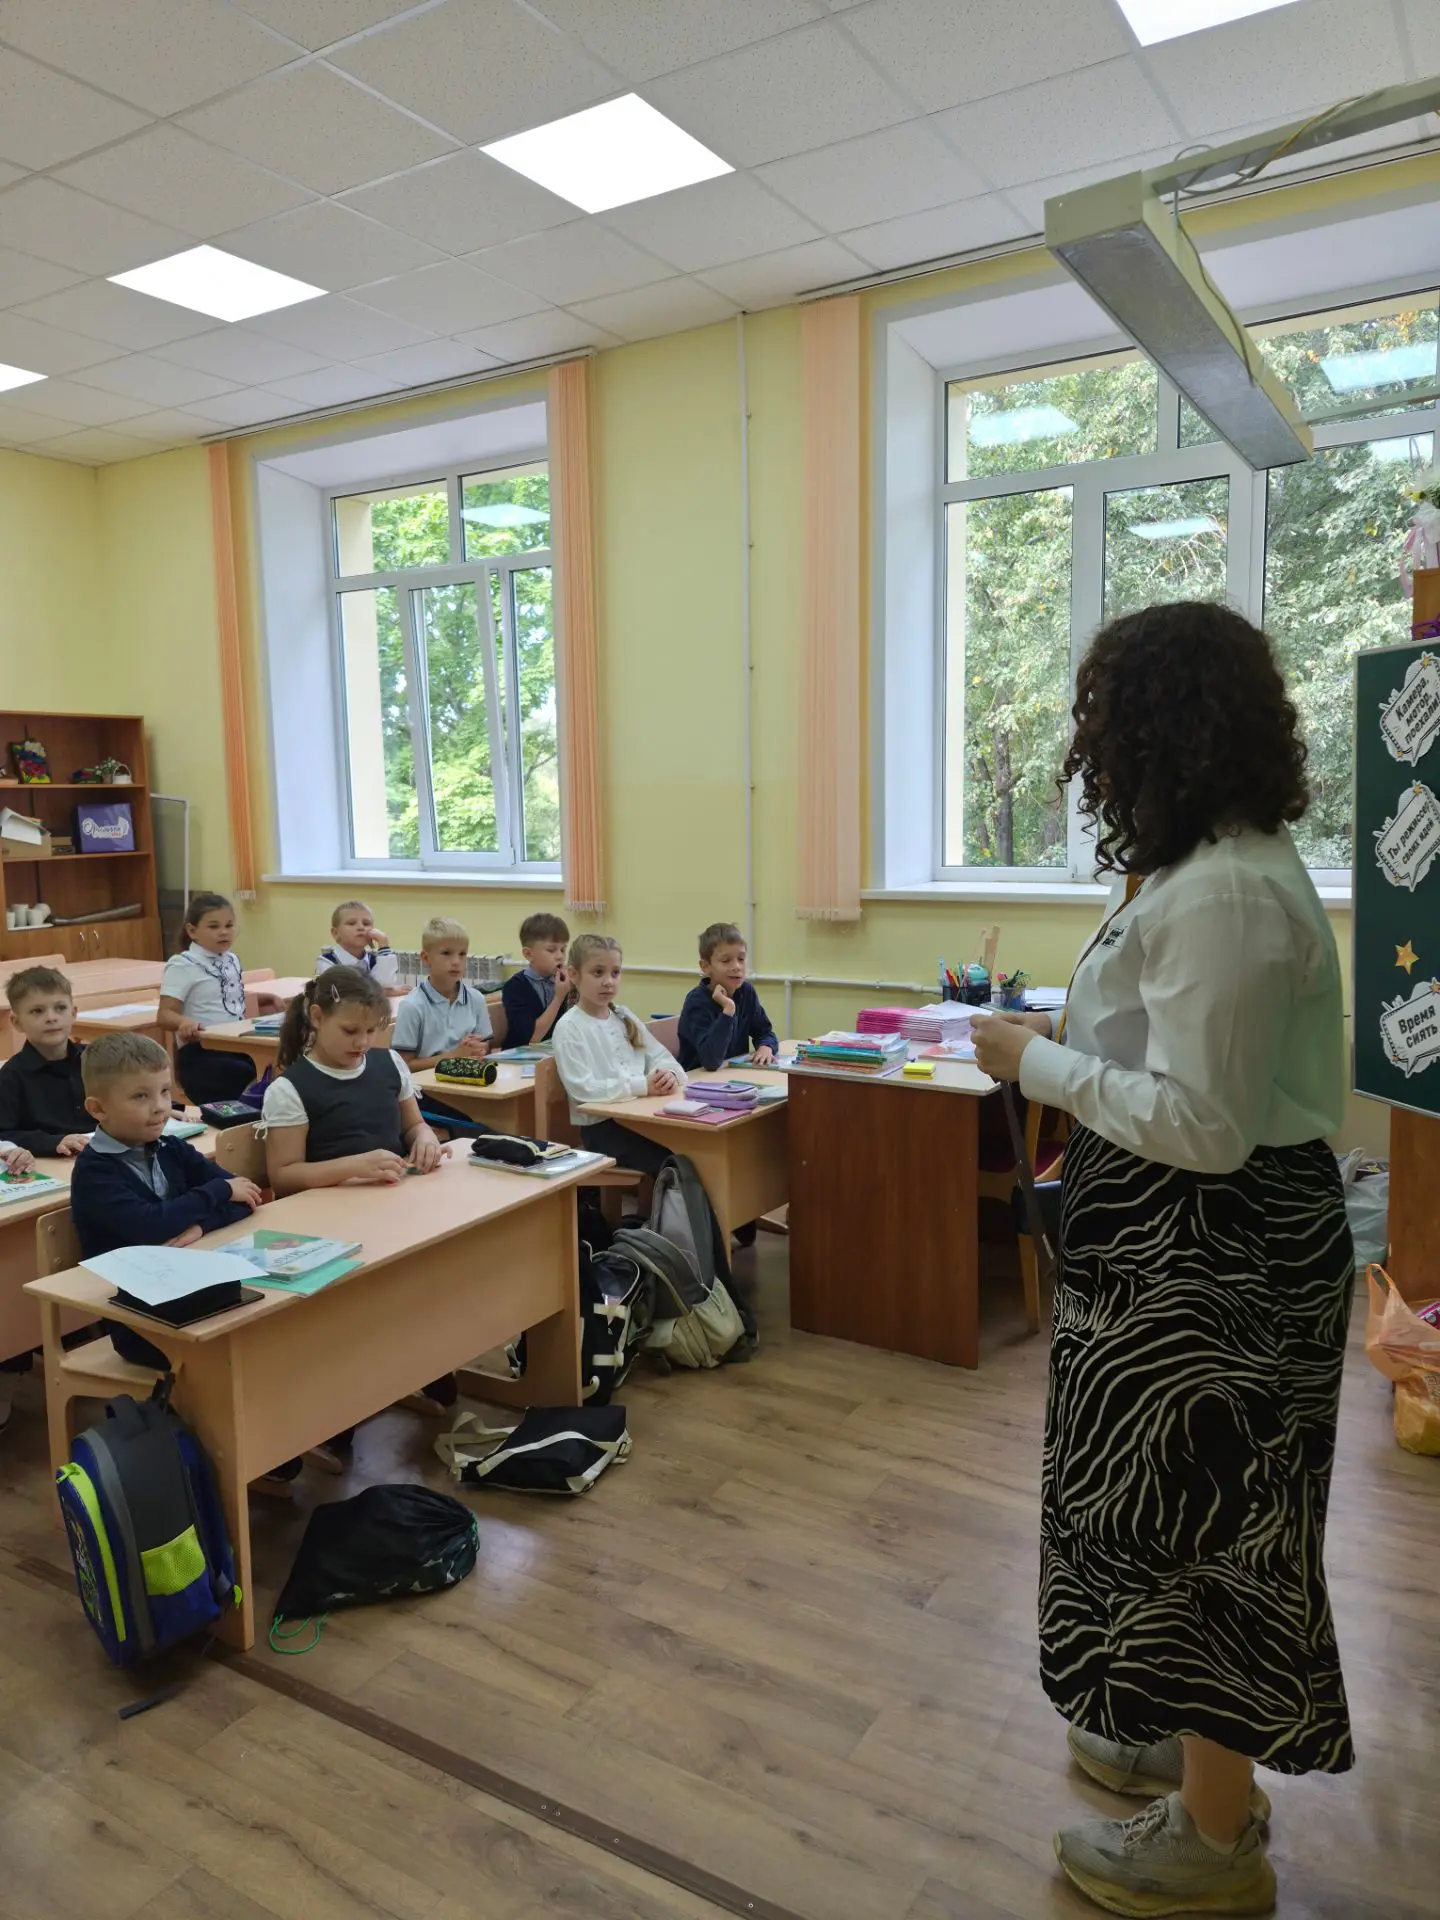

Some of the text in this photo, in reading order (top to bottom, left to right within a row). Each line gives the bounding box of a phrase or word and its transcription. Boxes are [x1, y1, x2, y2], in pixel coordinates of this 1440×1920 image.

[1405, 691, 1440, 744] поехали!
[1387, 842, 1401, 860] Ты
[1402, 839, 1420, 864] своих
[1398, 1005, 1436, 1034] Время
